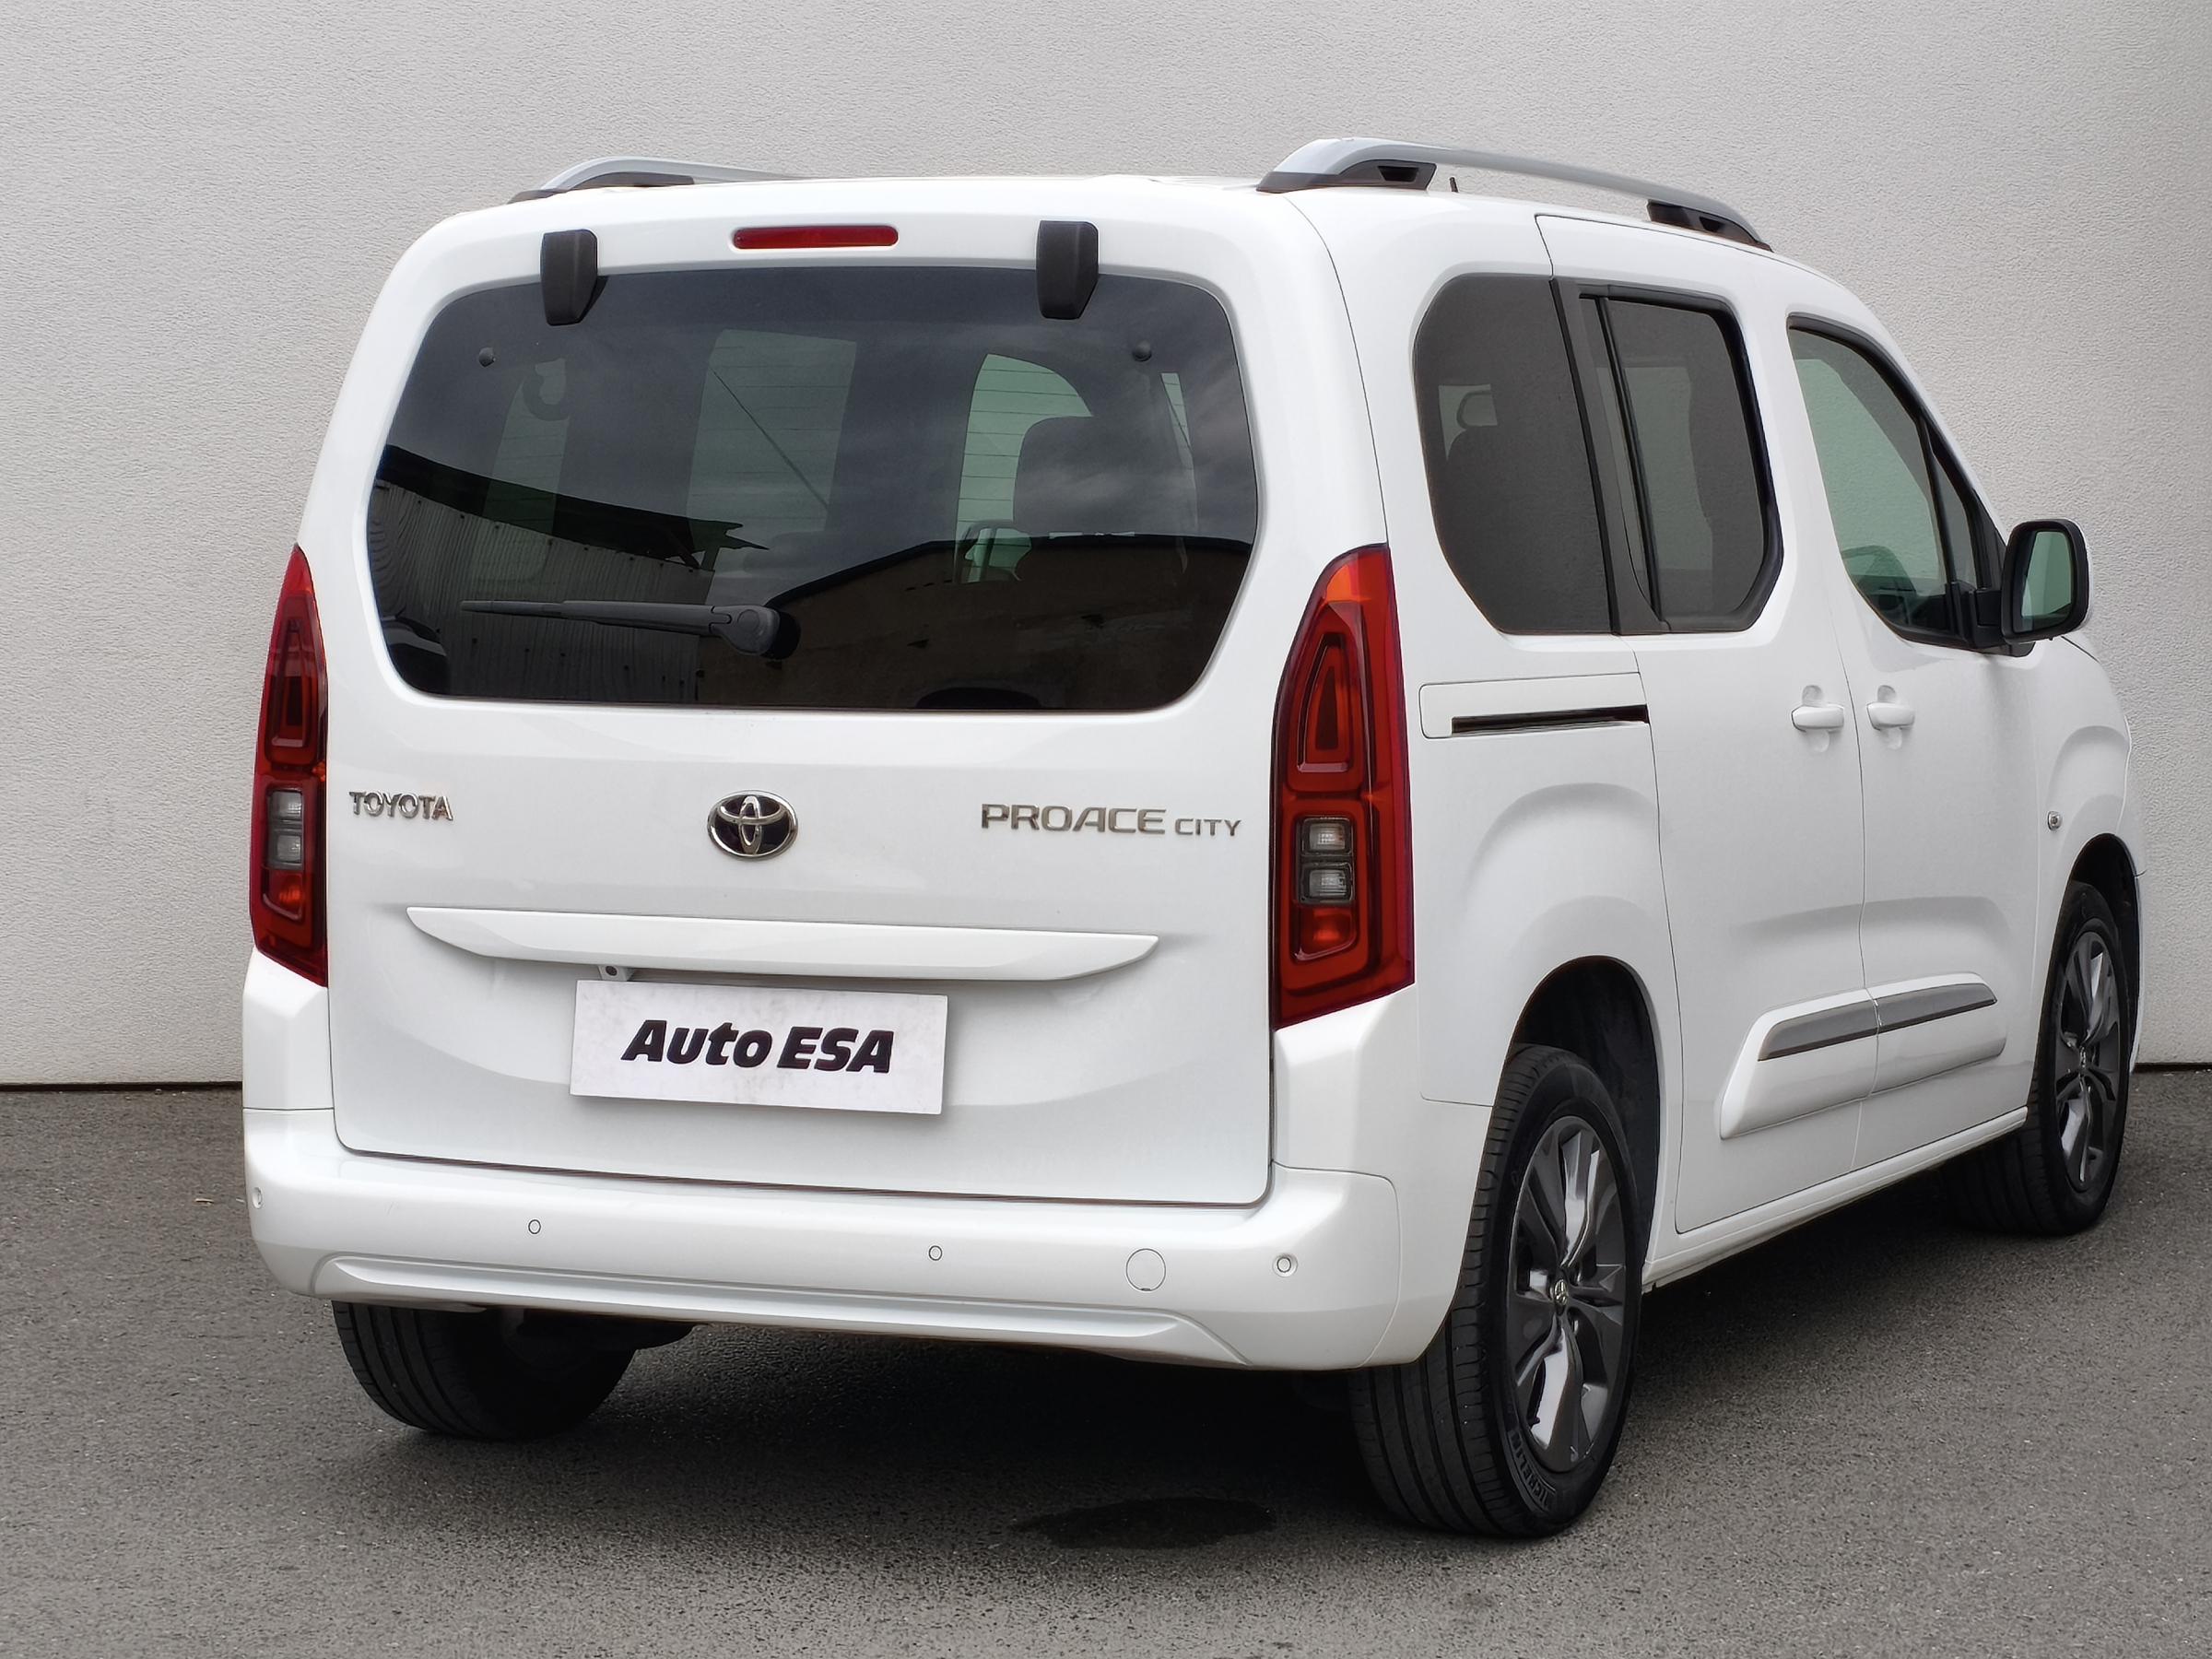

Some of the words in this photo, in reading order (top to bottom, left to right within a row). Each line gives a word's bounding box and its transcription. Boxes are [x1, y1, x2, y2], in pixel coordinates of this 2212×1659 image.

[349, 791, 453, 821] TOYOTA
[982, 804, 1166, 834] PROACE
[1175, 818, 1242, 836] CITY
[620, 1019, 772, 1068] Auto
[776, 1027, 895, 1074] ESA
